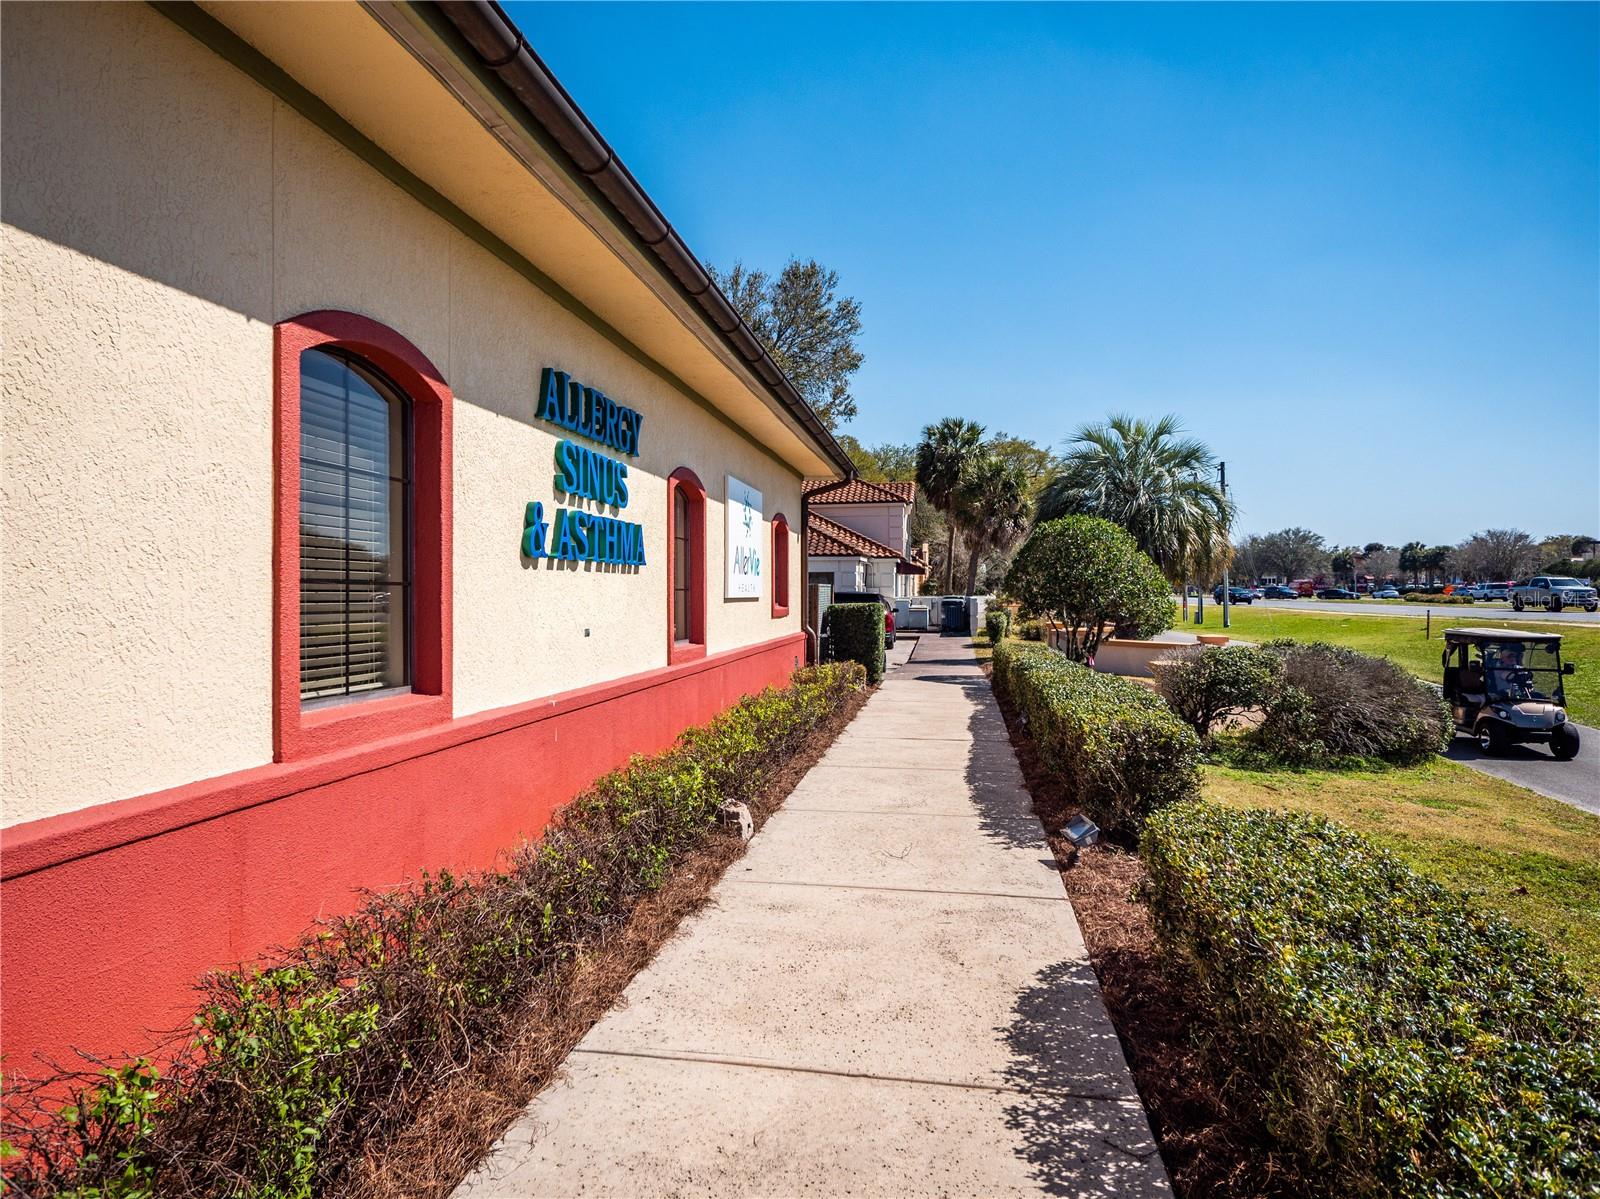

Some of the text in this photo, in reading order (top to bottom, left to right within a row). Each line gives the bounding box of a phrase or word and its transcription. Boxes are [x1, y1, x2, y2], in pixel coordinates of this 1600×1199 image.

[534, 367, 643, 457] ALLERGY
[554, 440, 629, 509] SINUS
[521, 501, 646, 566] & ASTHMA
[733, 545, 760, 577] AllerVie
